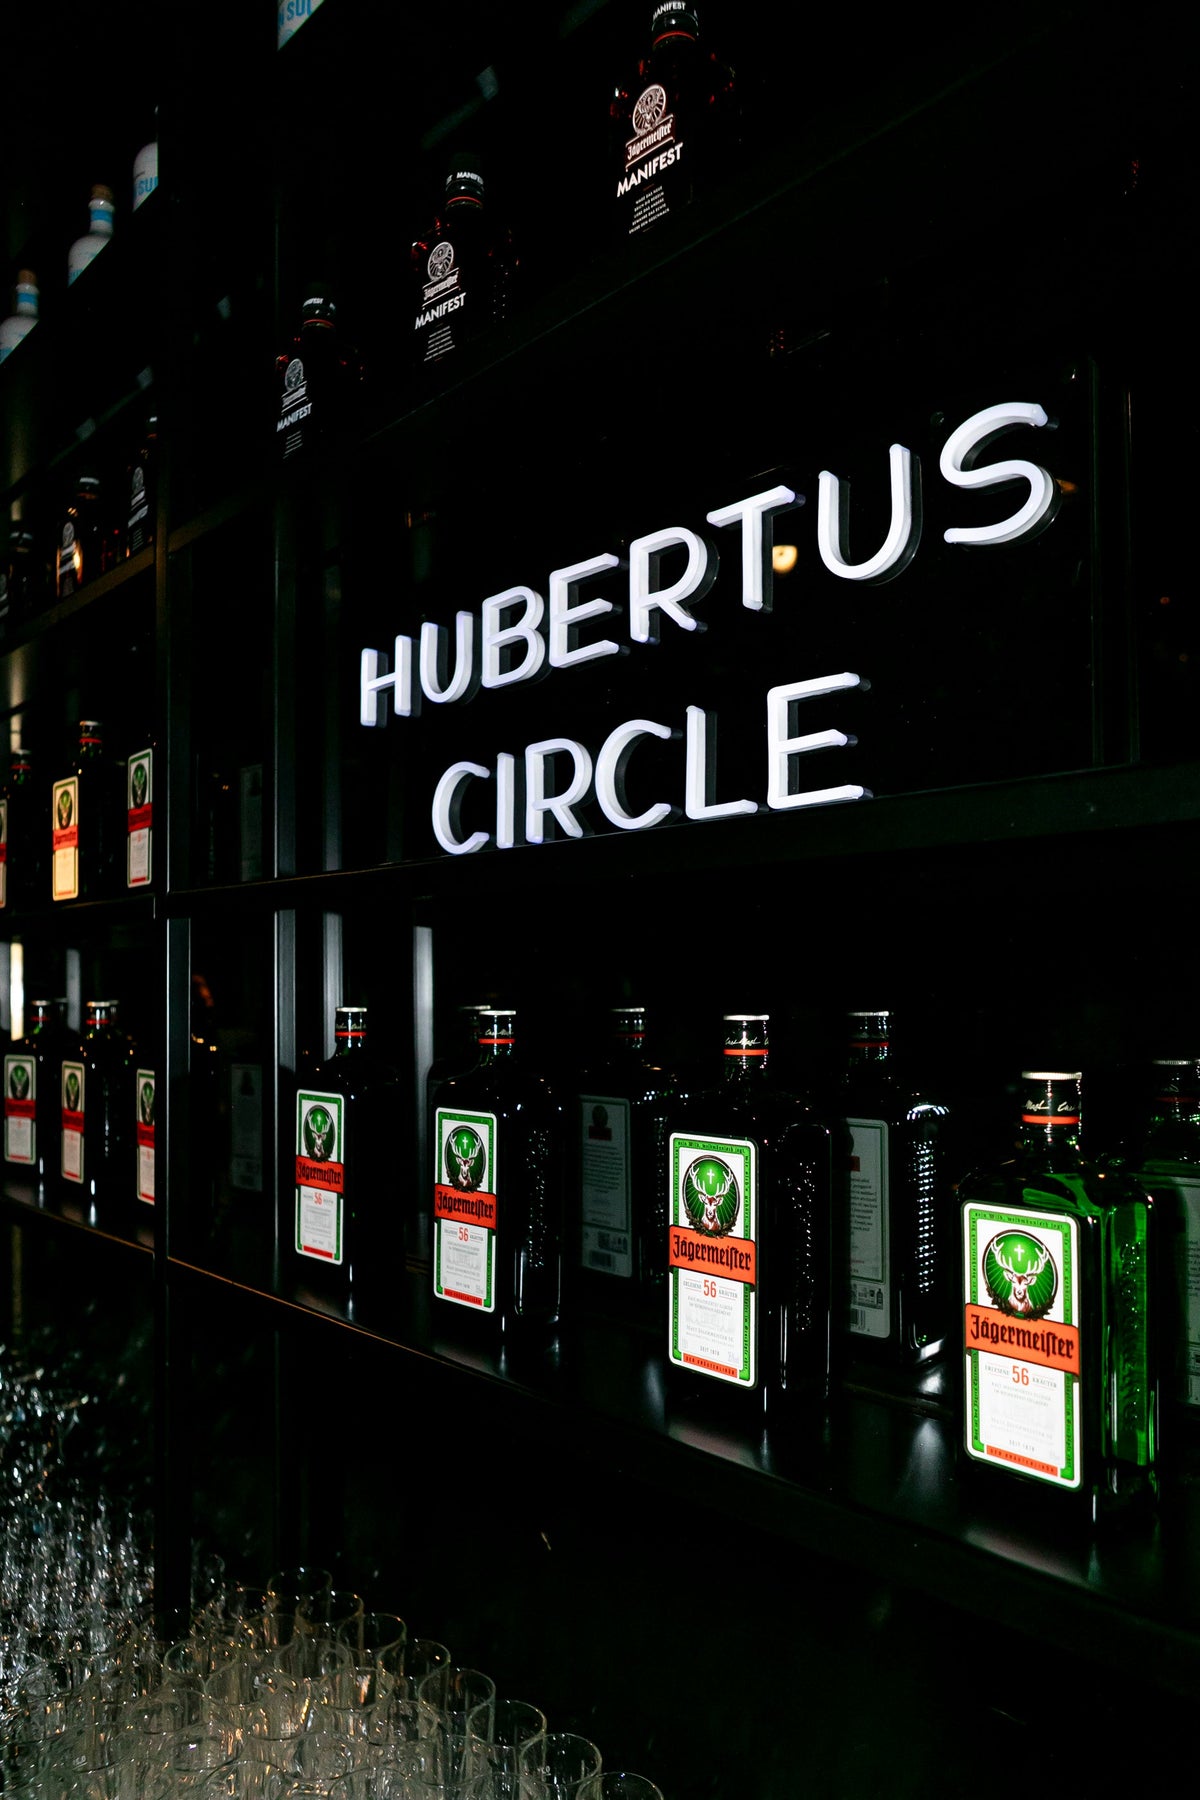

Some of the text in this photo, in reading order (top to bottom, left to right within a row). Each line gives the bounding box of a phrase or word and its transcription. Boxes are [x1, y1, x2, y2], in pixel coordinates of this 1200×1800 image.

[617, 142, 684, 198] MANIFEST
[415, 292, 467, 330] MANIFEST
[360, 402, 1056, 727] HUBERTUS
[431, 671, 868, 855] CIRCLE
[437, 1190, 494, 1220] Jägermeister
[458, 1226, 469, 1242] 56
[673, 1234, 751, 1272] Jägermeister
[703, 1279, 717, 1298] 56
[970, 1313, 1074, 1360] Jägermeister
[1012, 1365, 1029, 1386] 56
